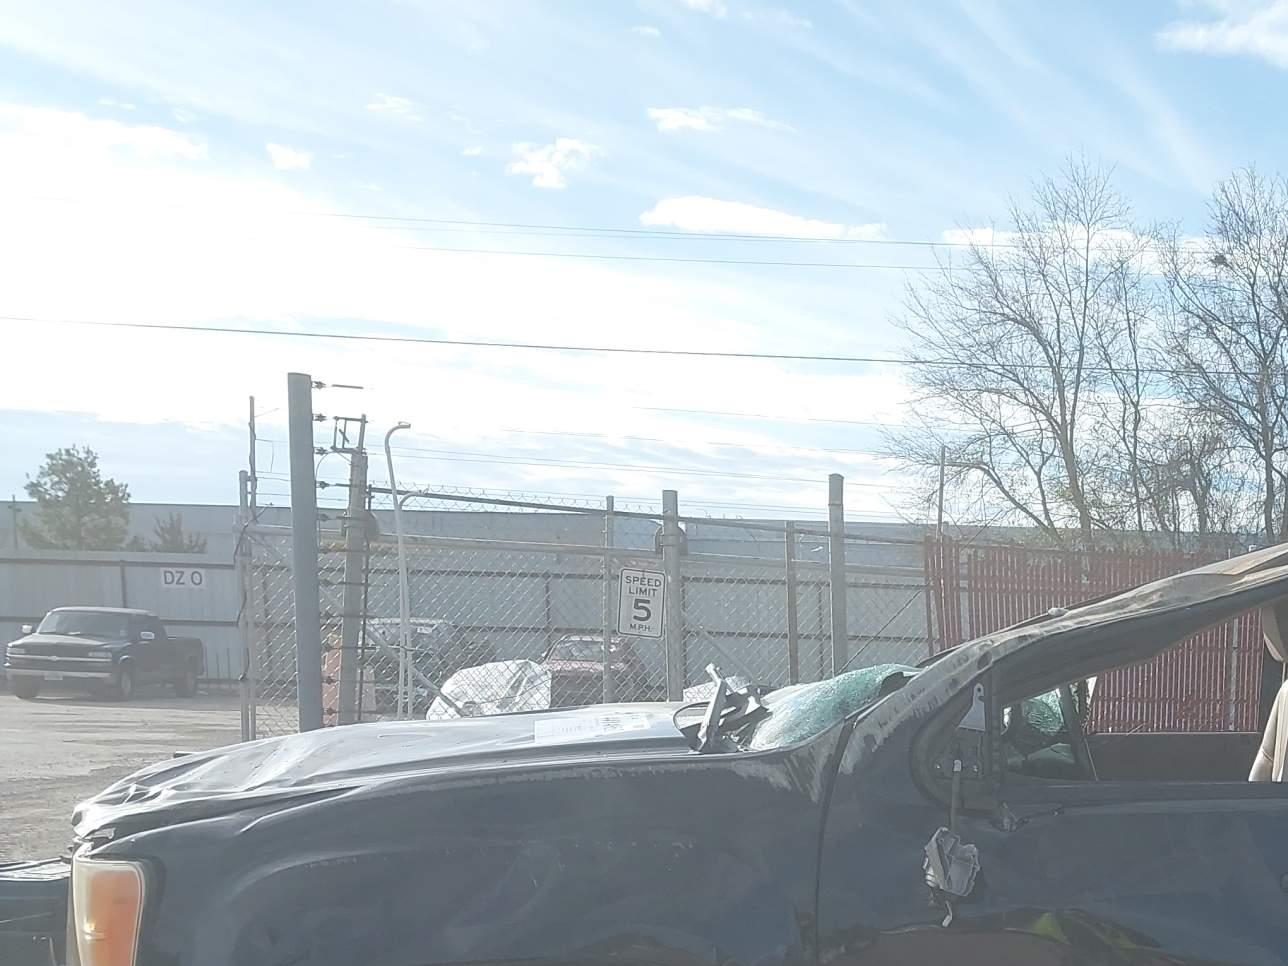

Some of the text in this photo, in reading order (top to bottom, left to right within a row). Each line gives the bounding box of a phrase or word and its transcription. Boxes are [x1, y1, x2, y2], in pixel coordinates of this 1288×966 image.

[625, 575, 662, 587] SPEED
[628, 586, 658, 597] LIMIT
[633, 598, 652, 622] 5
